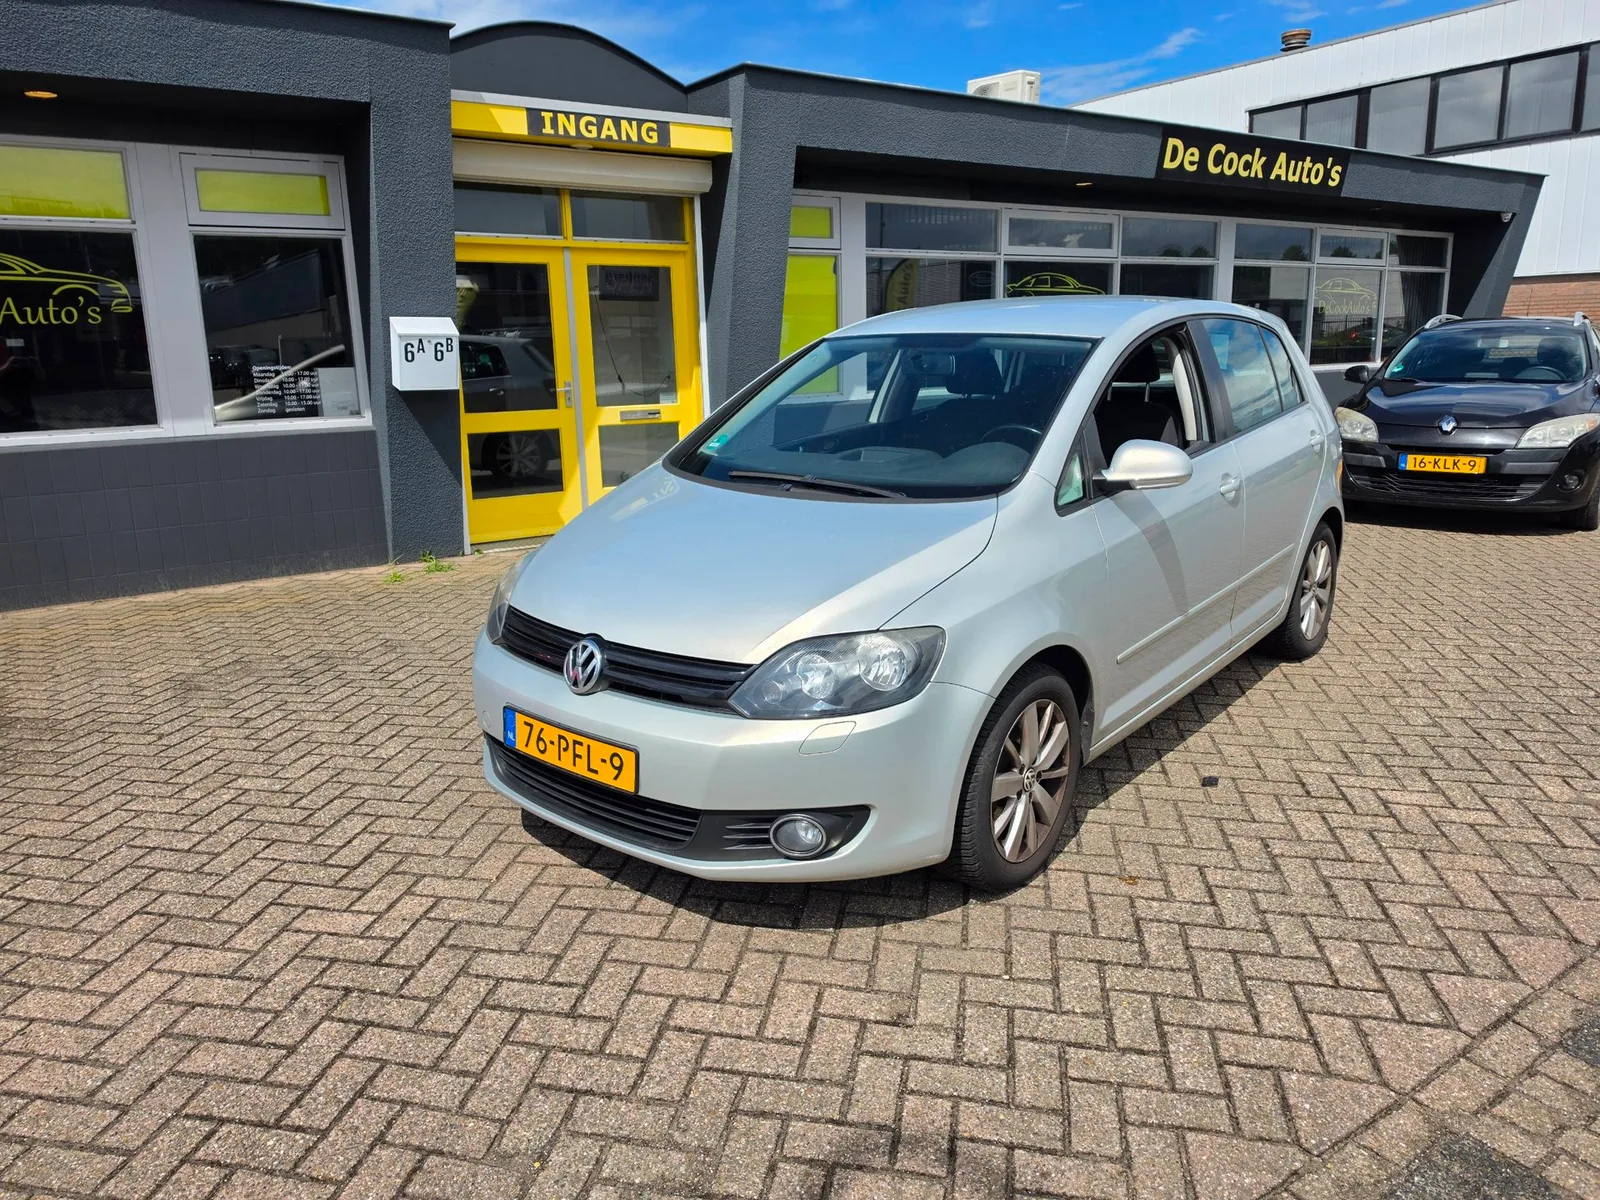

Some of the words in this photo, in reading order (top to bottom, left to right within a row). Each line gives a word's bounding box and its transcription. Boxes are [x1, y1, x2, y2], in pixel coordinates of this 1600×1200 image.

[541, 111, 658, 144] INGANG
[1163, 137, 1200, 172] De
[1207, 143, 1267, 179] Cock
[1269, 152, 1343, 187] Auto's
[0, 296, 102, 325] Auto's
[1413, 457, 1477, 471] 16-KLK-9
[507, 730, 515, 741] NL
[523, 721, 624, 781] 76-PFL-9
